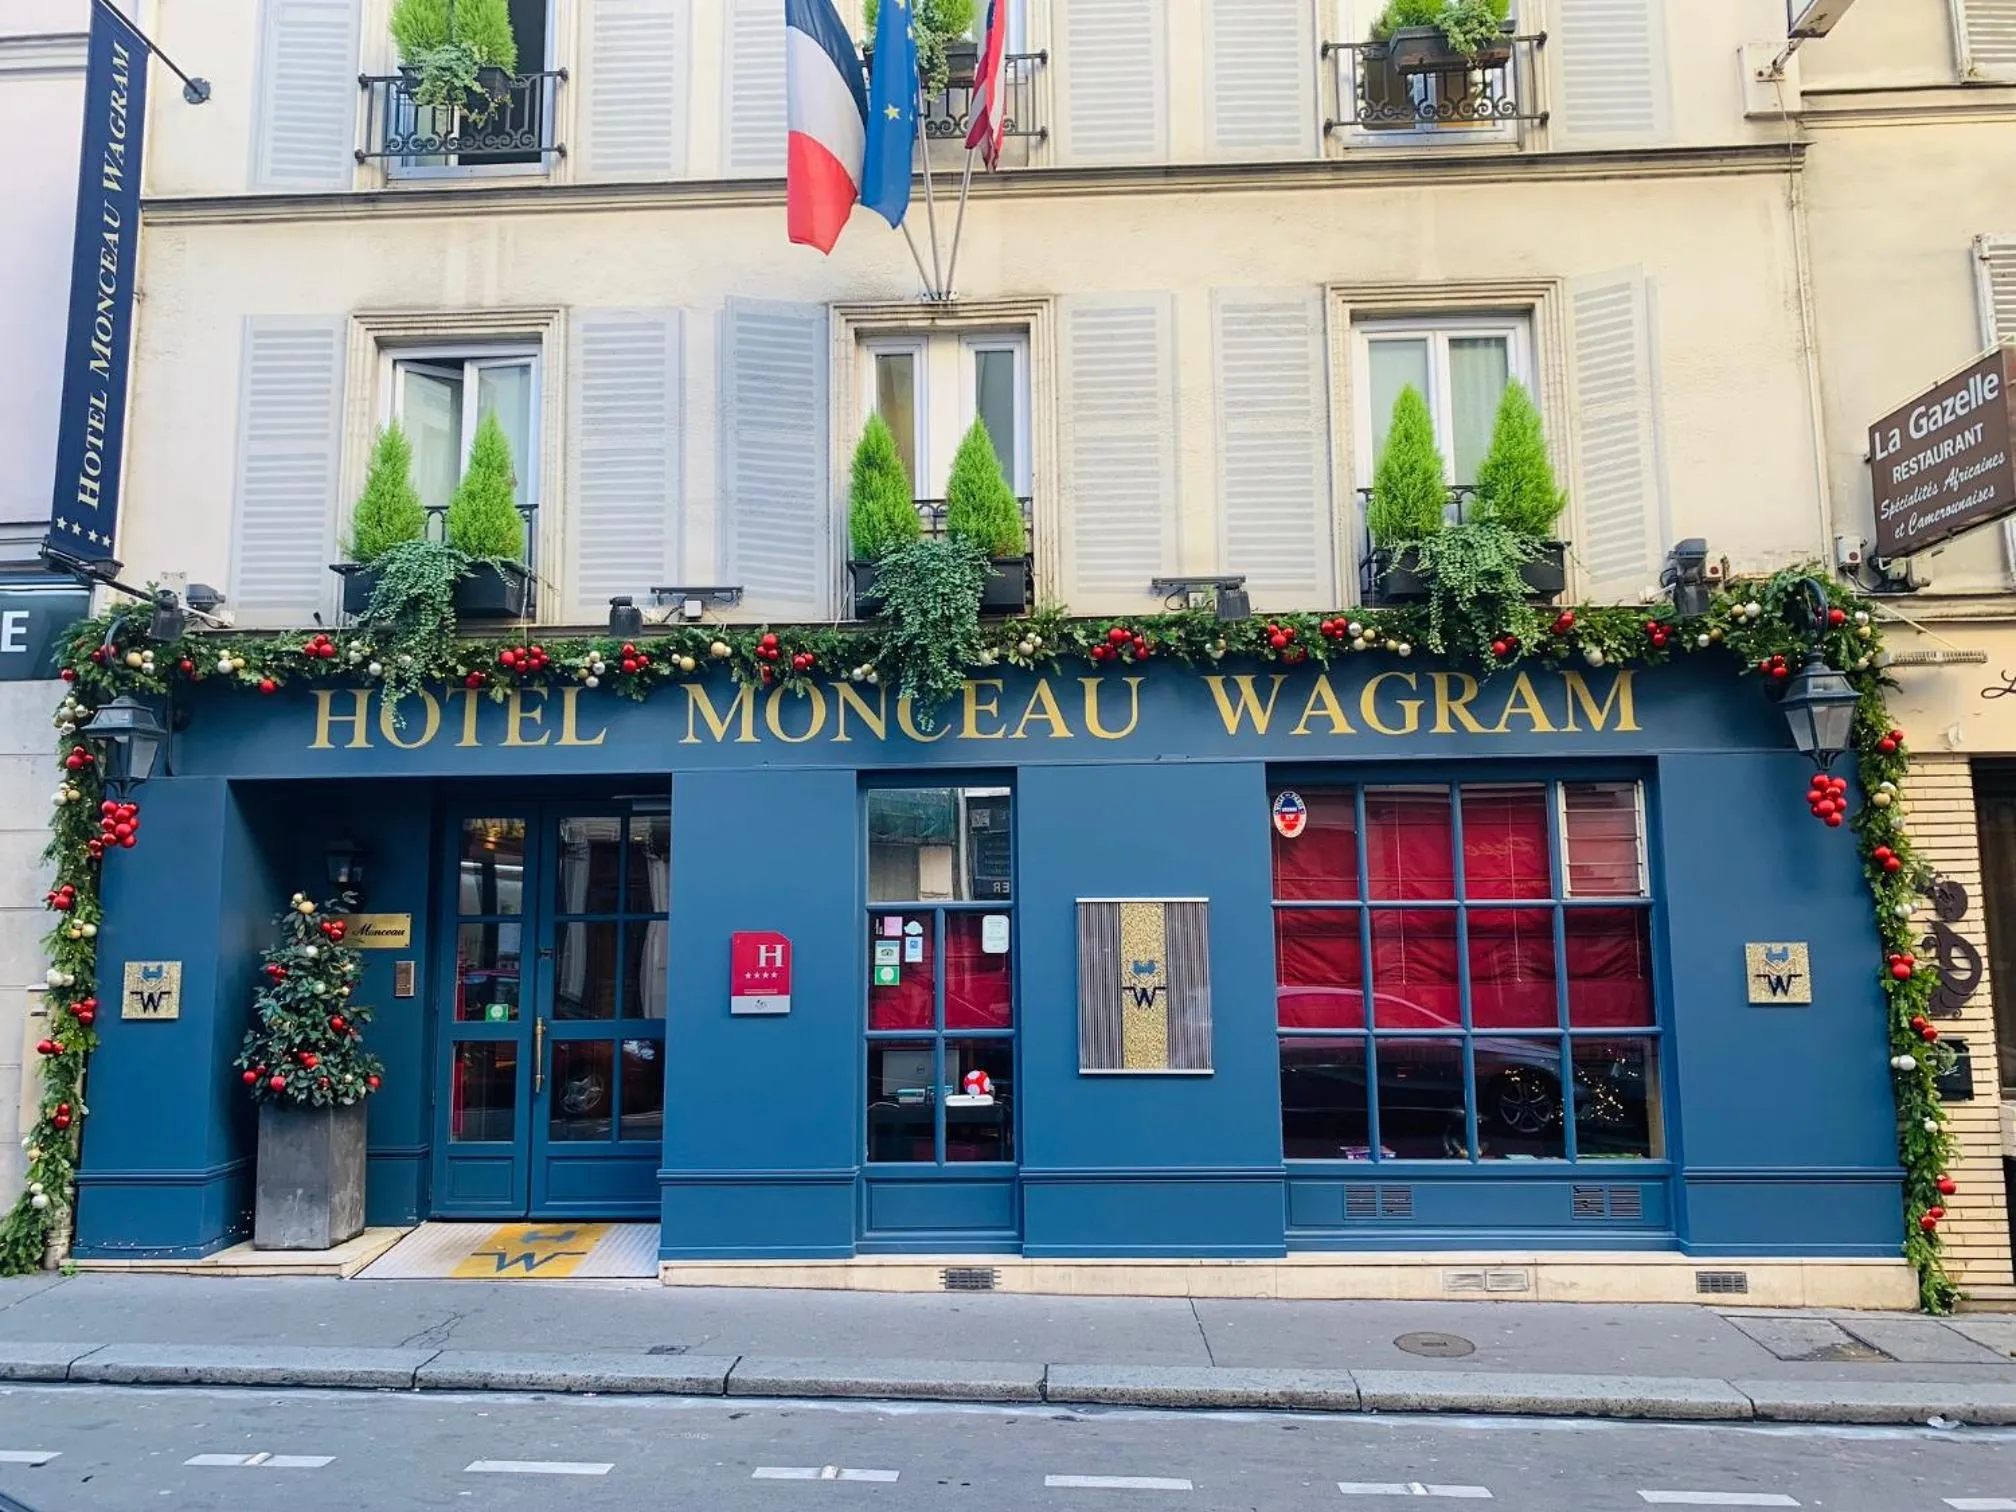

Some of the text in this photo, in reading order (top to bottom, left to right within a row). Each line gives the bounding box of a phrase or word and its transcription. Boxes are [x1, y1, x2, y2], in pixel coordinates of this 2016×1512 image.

[77, 40, 129, 511] HOTEL MONCEAU WAGRAM
[1874, 371, 2000, 461] La Gazelle
[1892, 423, 1984, 484] RESTAURANT
[1943, 450, 2006, 492] Africaines
[1895, 485, 1996, 539] et Camerounaises
[308, 669, 1643, 750] HOTEL MONCEAU WAGRAM
[352, 923, 406, 937] Monceau
[756, 944, 786, 968] H
